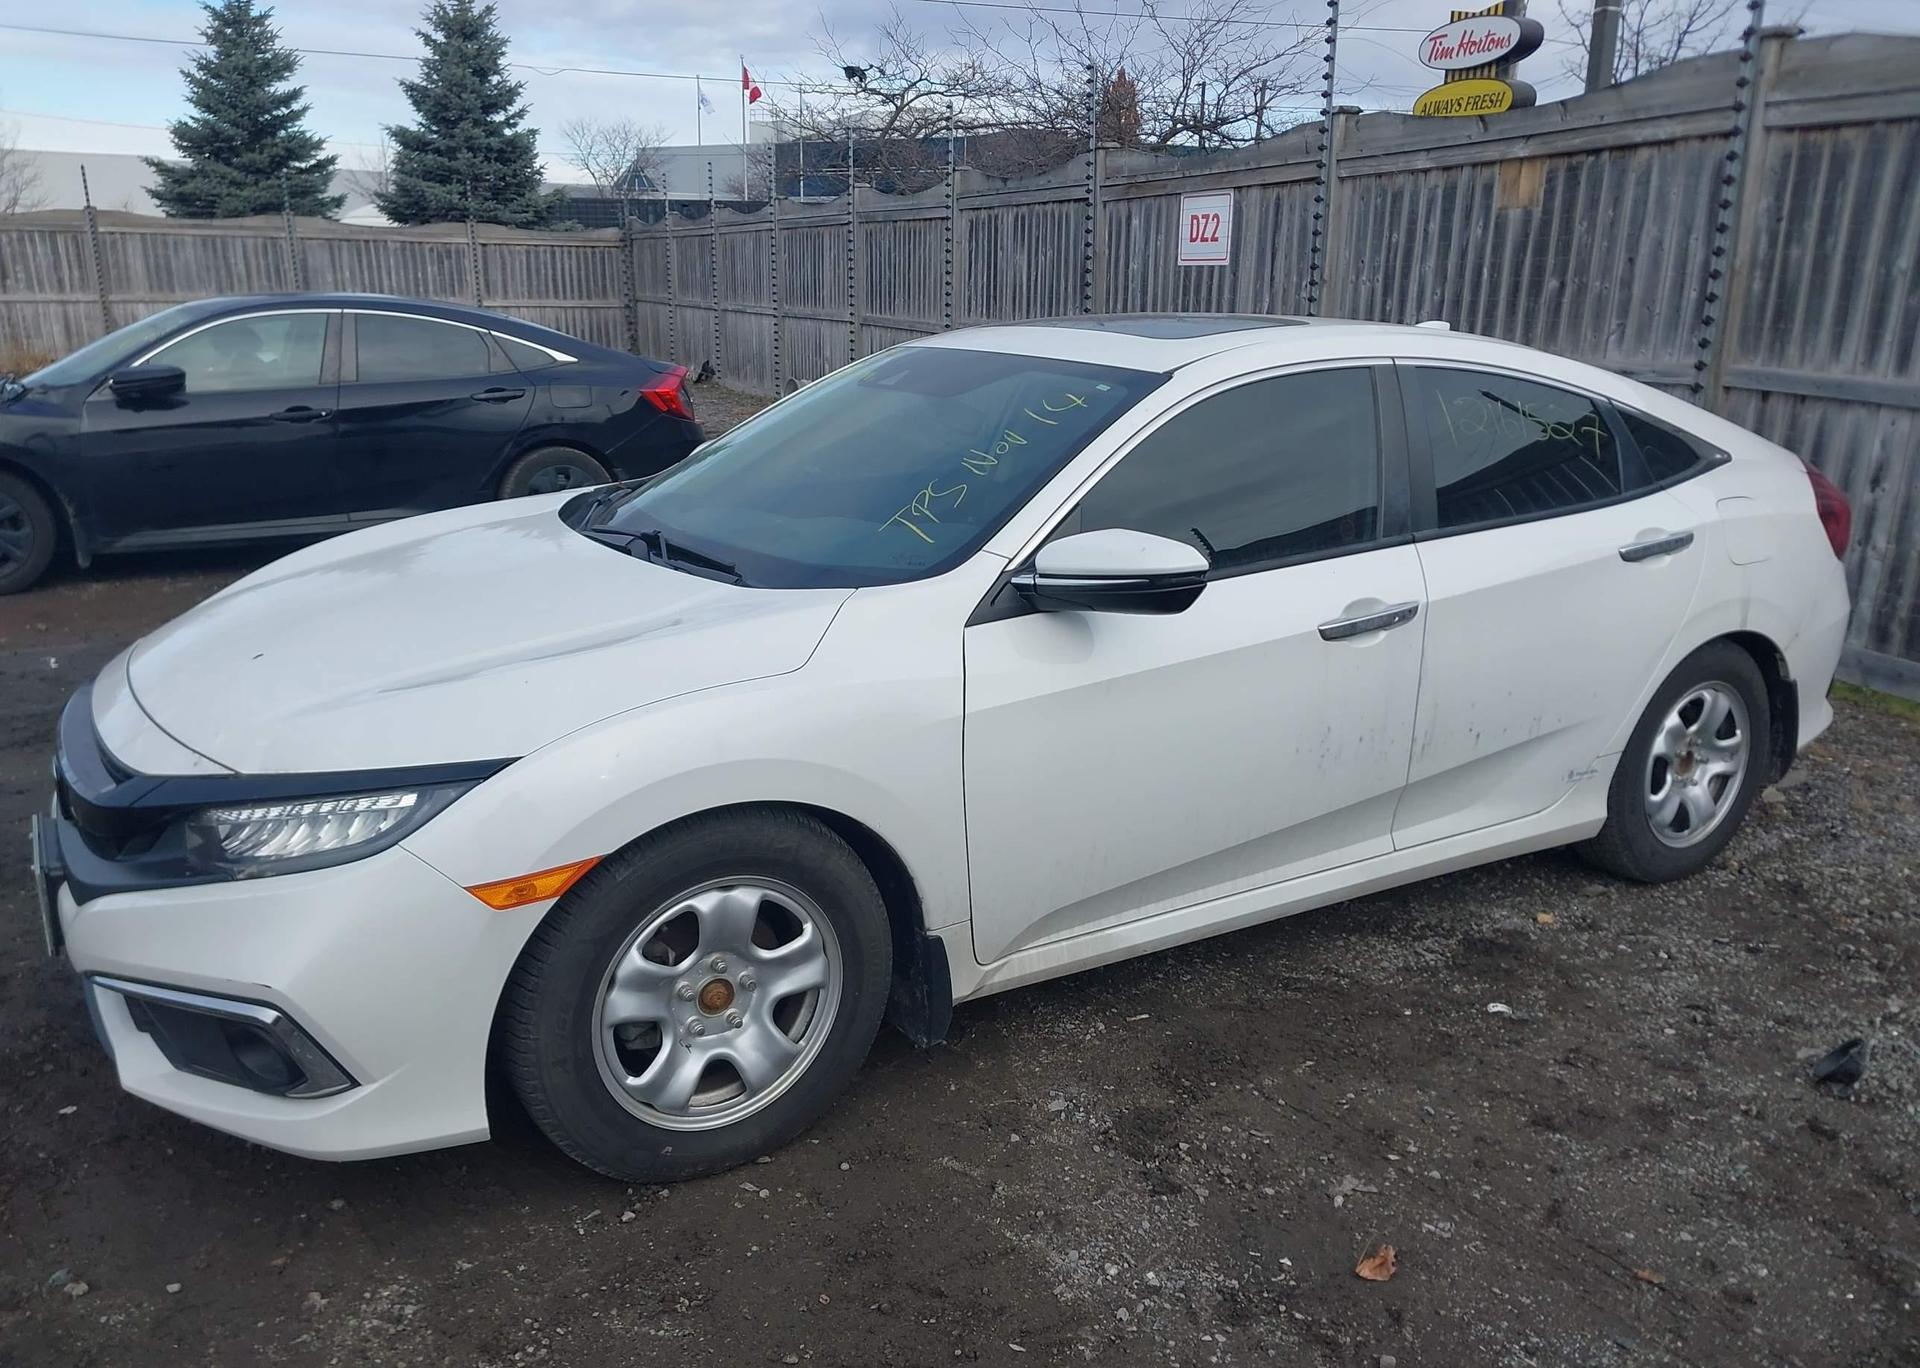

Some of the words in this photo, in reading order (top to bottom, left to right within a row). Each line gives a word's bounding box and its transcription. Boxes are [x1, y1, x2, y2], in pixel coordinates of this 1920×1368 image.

[1428, 33, 1454, 64] Tim
[1456, 29, 1512, 59] Hortons
[1420, 96, 1465, 116] ALWAYS
[1463, 91, 1507, 113] FRESH
[1189, 213, 1221, 243] DZ2
[877, 478, 968, 544] TPS
[960, 429, 1028, 476] Nov
